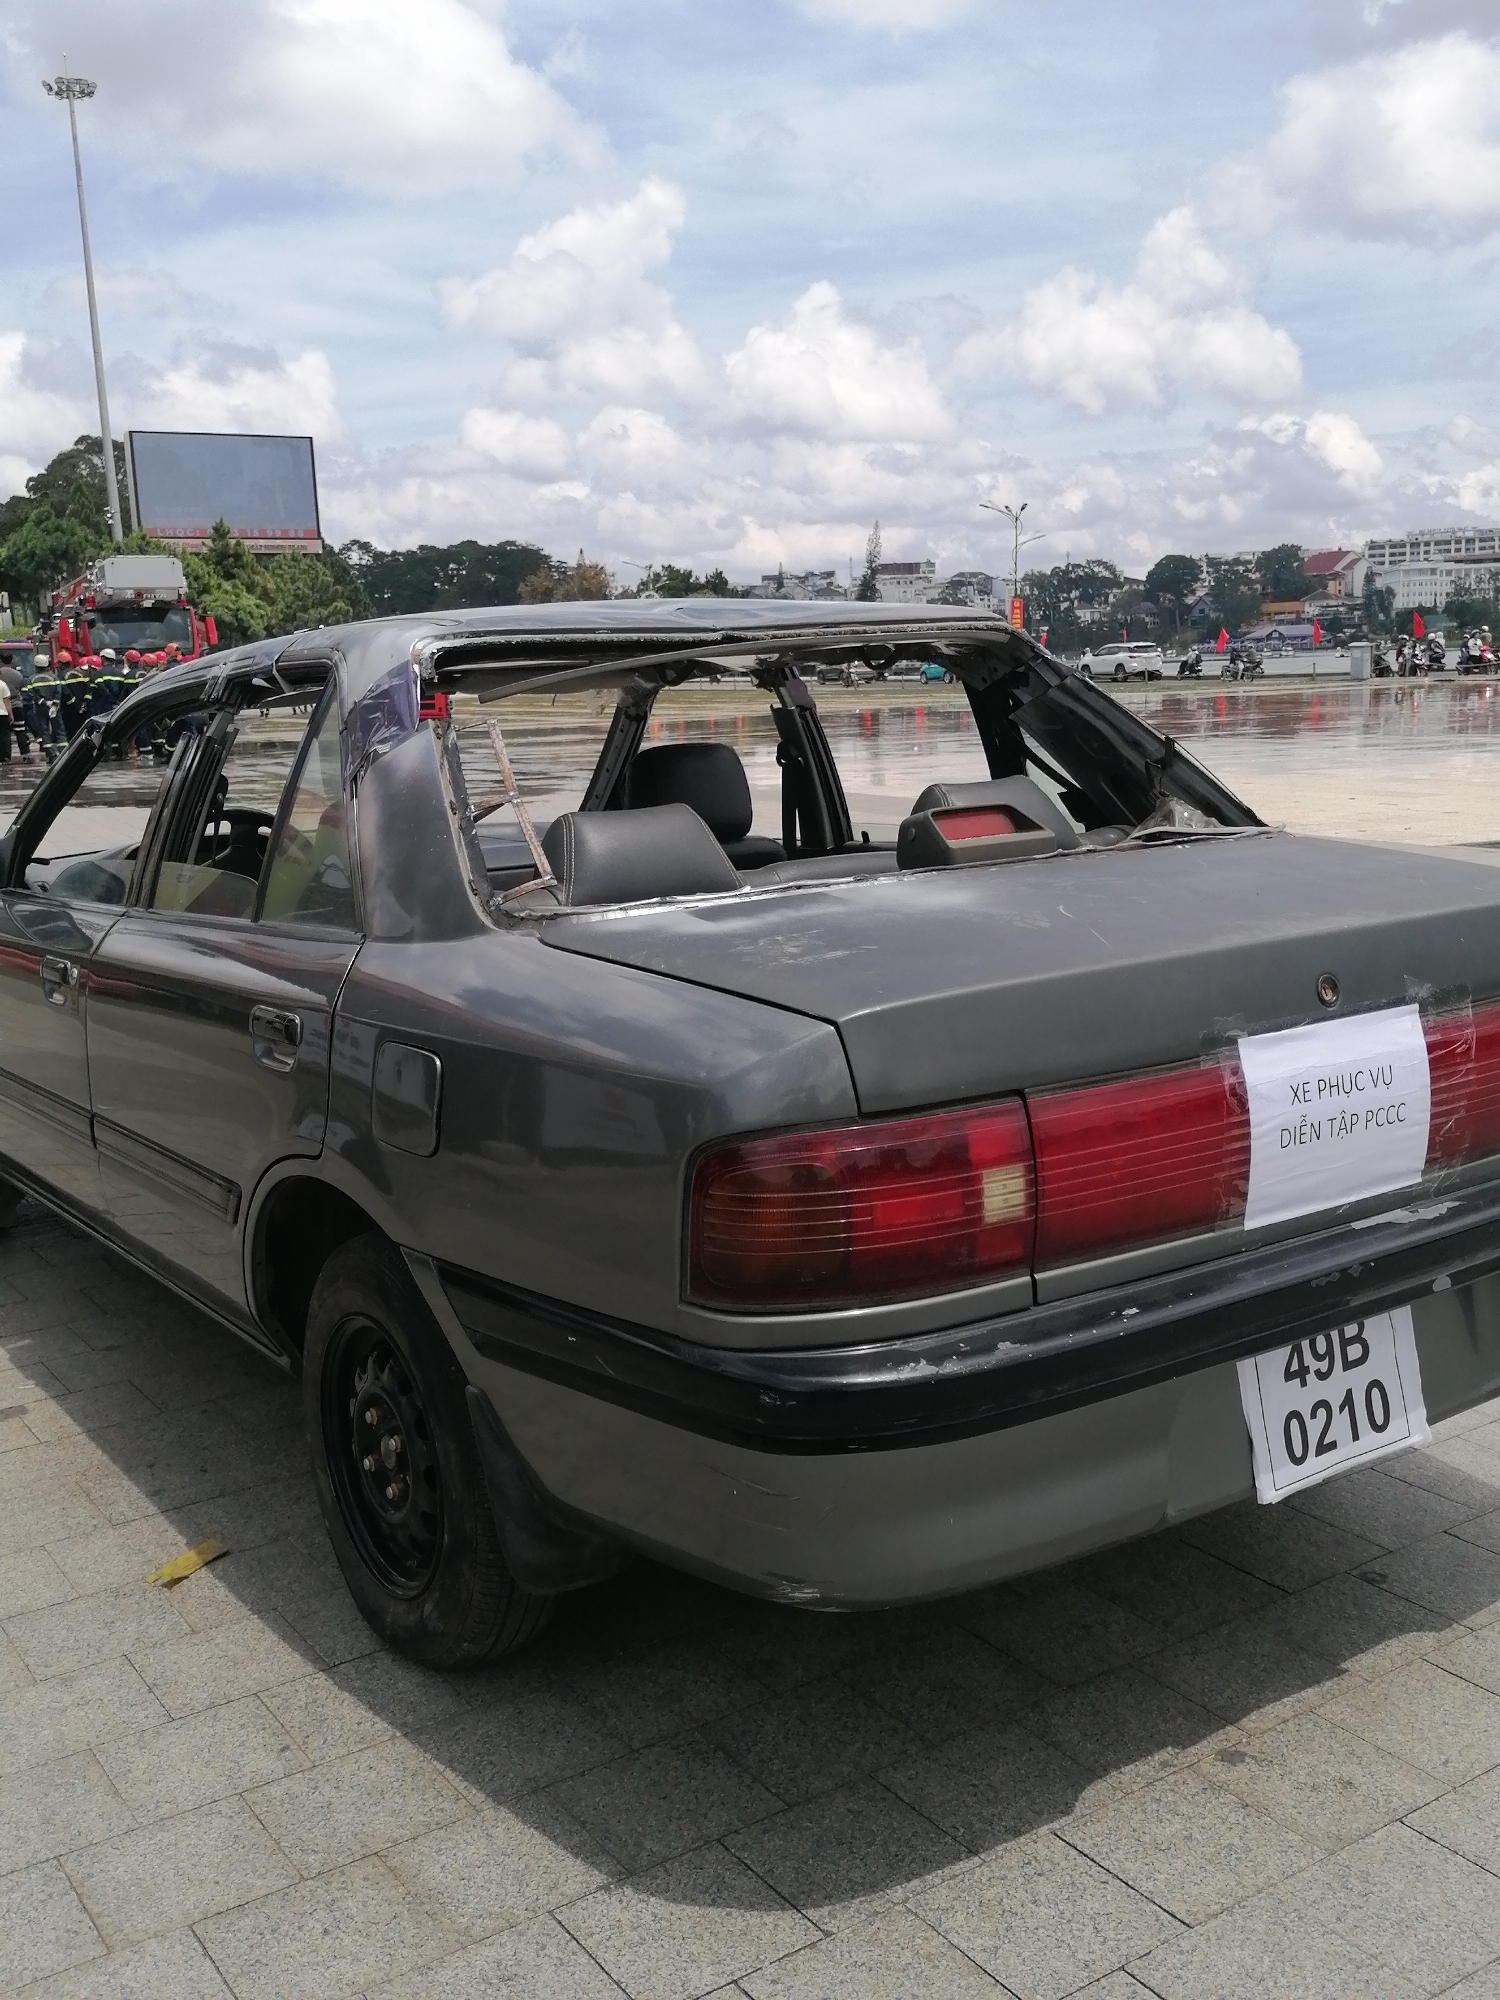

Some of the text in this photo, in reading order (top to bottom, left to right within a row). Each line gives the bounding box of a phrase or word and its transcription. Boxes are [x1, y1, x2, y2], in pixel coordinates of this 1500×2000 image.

[1289, 1064, 1394, 1106] XE PHỤC VỤ
[1280, 1102, 1407, 1149] DIỄN TẬP PCCC
[1283, 1319, 1370, 1389] 49B
[1283, 1378, 1391, 1467] 0210
